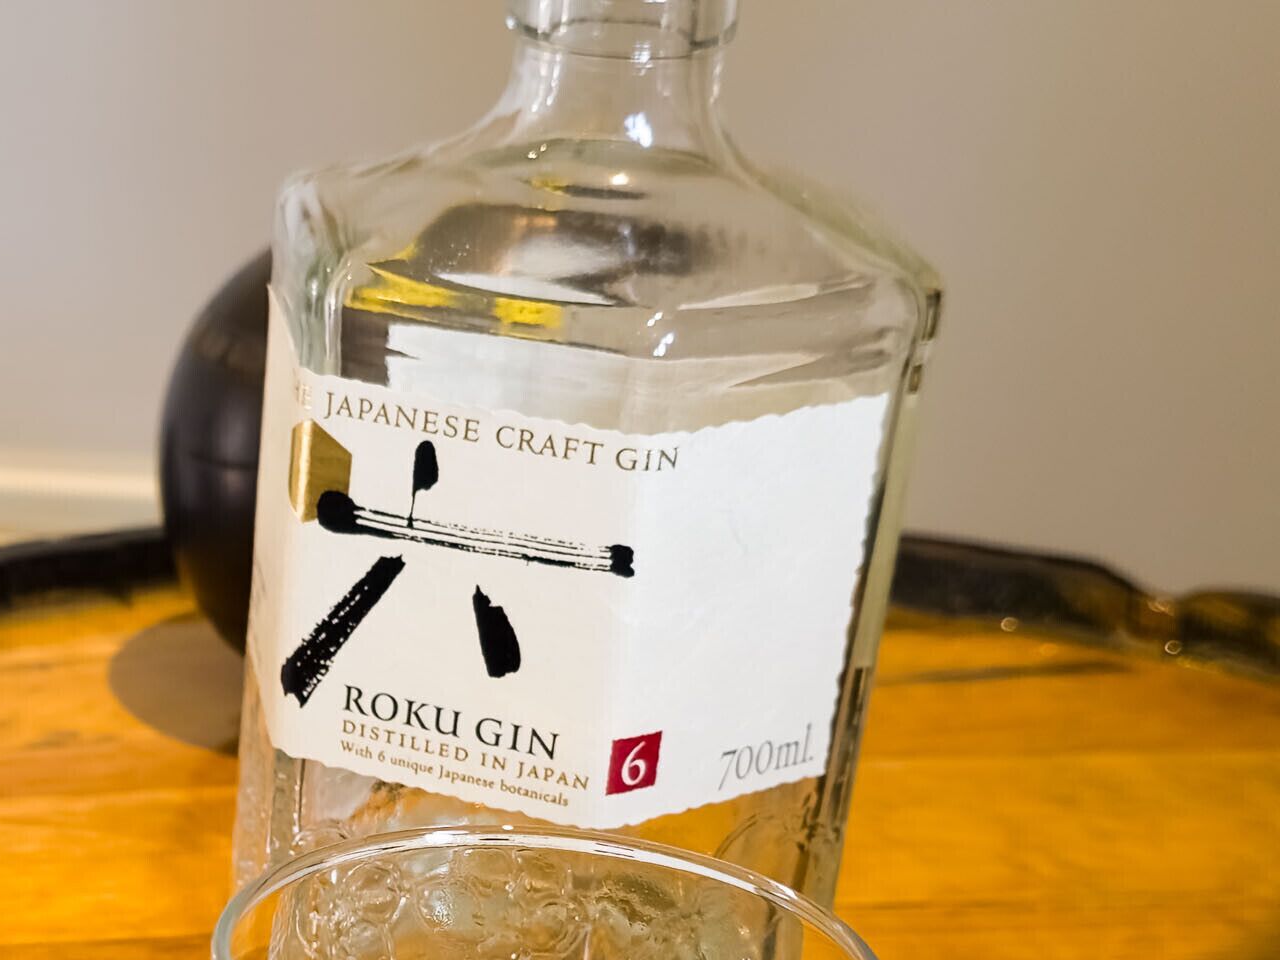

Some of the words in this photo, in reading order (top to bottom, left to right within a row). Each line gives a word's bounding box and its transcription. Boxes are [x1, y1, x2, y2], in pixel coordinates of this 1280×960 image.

[324, 391, 480, 443] JAPANESE
[496, 425, 604, 465] CRAFT
[615, 447, 678, 472] GIN
[281, 440, 635, 707] 六
[342, 719, 469, 762] DISTILLED
[481, 752, 507, 772] IN
[516, 761, 589, 791] JAPAN
[344, 684, 462, 738] ROKU
[475, 717, 560, 760] GIN
[341, 740, 372, 760] With
[377, 752, 386, 762] 6
[390, 755, 433, 775] unique
[438, 765, 494, 788] Japanese
[500, 779, 569, 807] botanicals
[621, 740, 646, 786] 6
